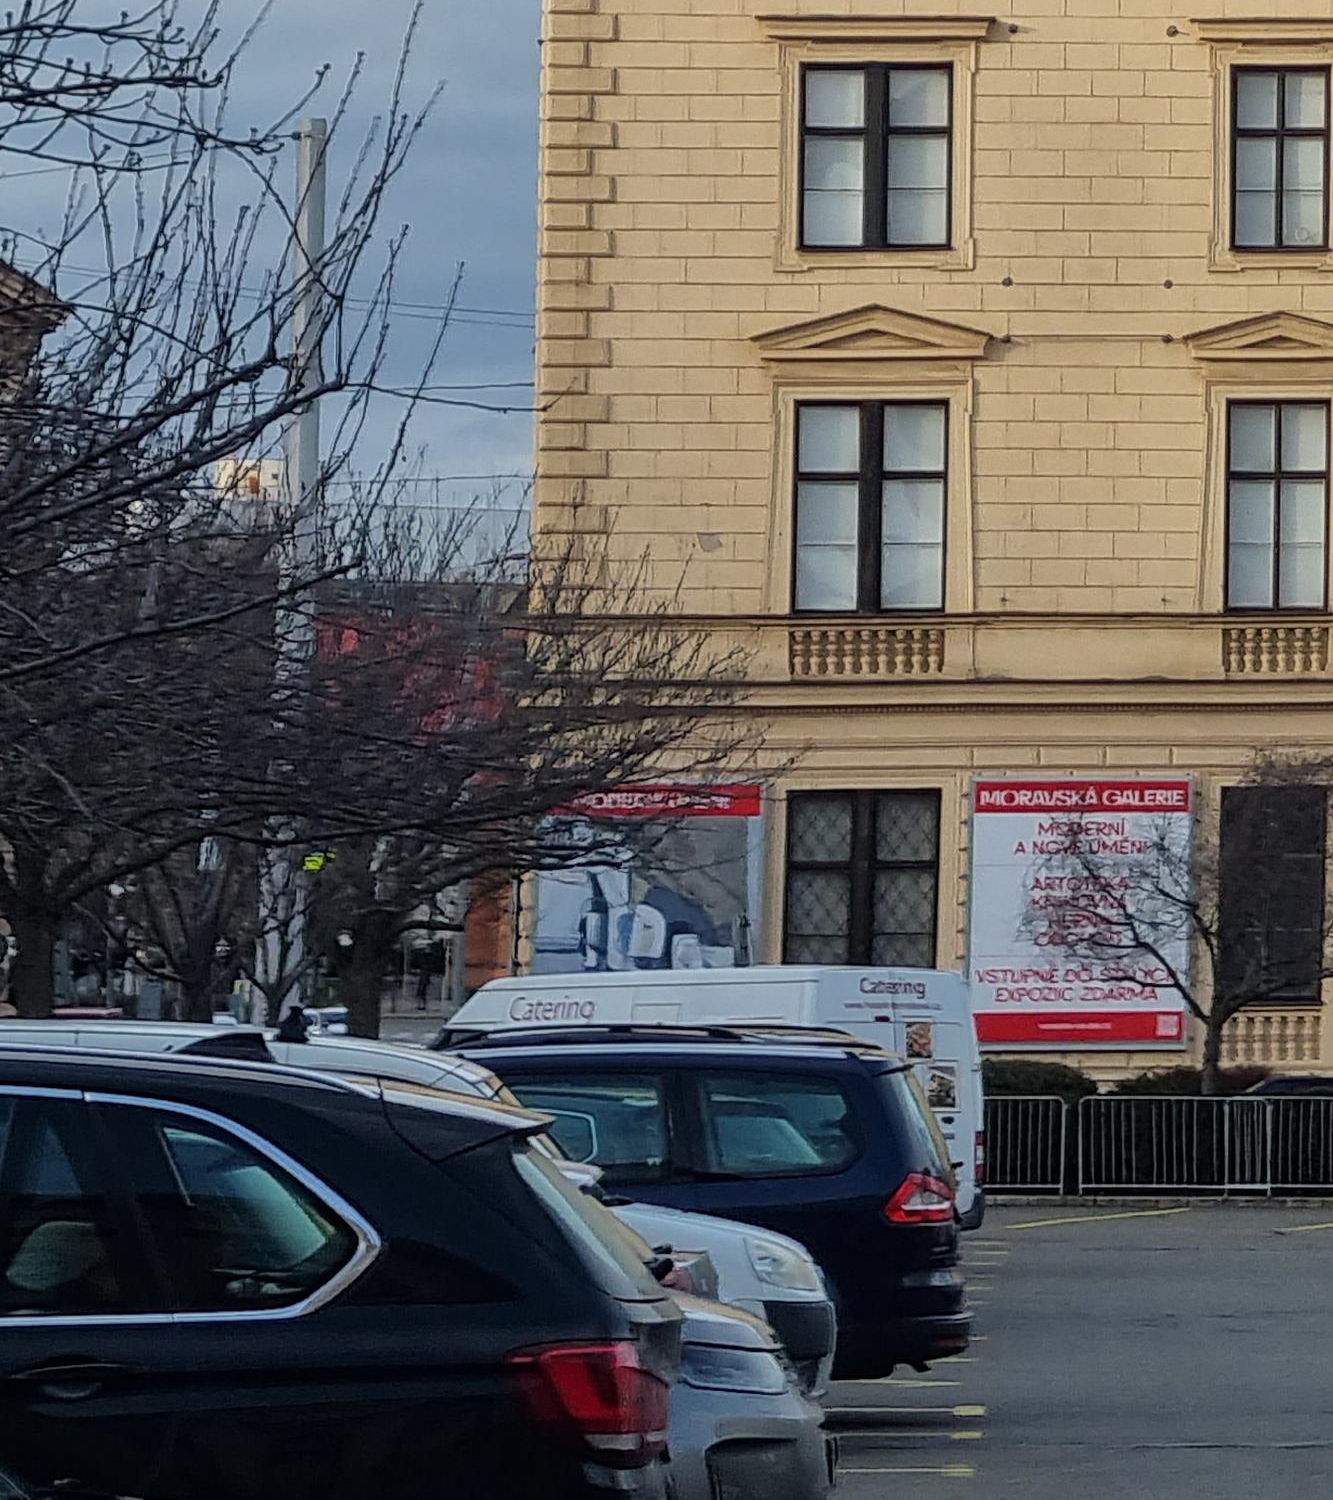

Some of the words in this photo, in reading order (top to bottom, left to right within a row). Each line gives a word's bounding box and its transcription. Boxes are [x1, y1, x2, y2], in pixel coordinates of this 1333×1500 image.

[980, 787, 1098, 806] MORAVSKÁ
[1102, 789, 1185, 806] GALERIE
[1013, 840, 1026, 854] A
[859, 976, 927, 1000] Catering
